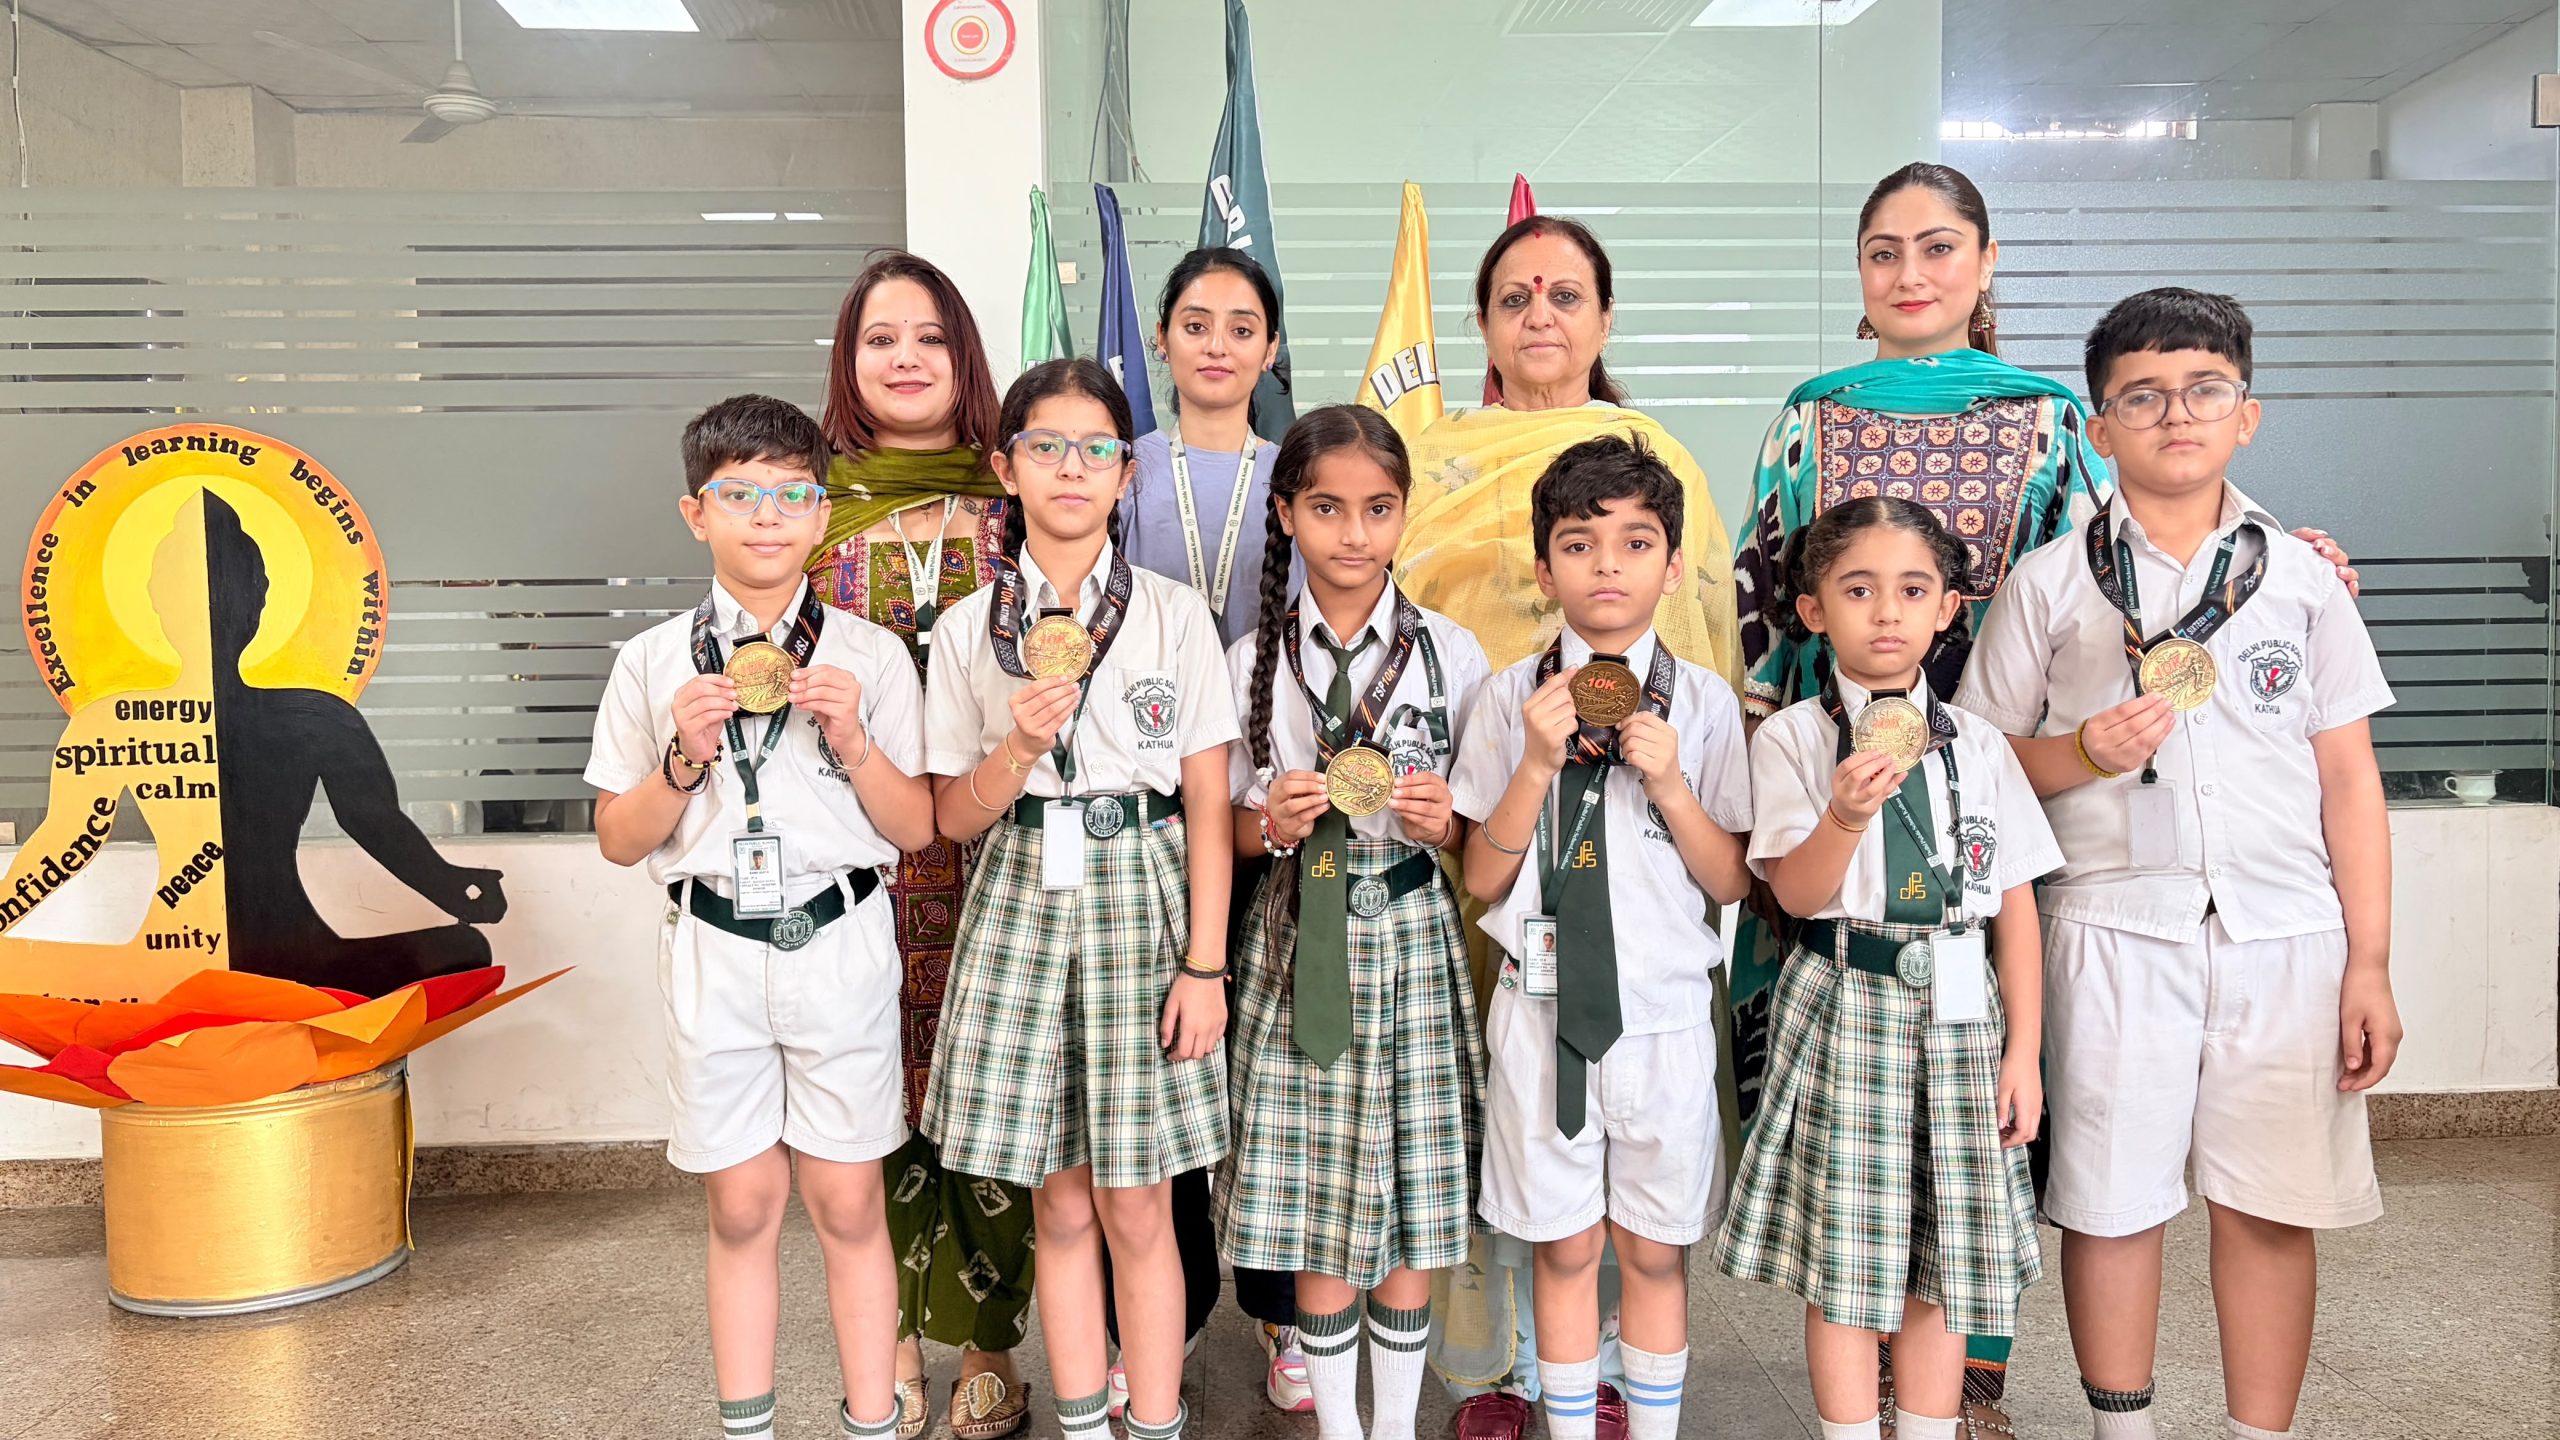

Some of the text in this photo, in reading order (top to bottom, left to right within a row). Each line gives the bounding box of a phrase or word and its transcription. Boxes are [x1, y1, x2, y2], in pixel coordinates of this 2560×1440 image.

[1369, 341, 1439, 410] DEL
[26, 532, 76, 696] Excellence
[62, 478, 97, 508] in
[121, 432, 261, 466] learning
[290, 459, 363, 545] begins
[2186, 614, 2208, 635] SIXTEEN
[2238, 643, 2261, 662] DELHI
[2261, 640, 2291, 650] PUBLIC
[1429, 667, 1437, 683] Public
[1121, 684, 1138, 704] DELHI
[1135, 677, 1164, 689] PUBLIC
[1588, 678, 1617, 690] 10K
[115, 699, 212, 724] energy
[2254, 704, 2281, 714] KATHUA
[766, 735, 775, 748] Delhi
[1137, 740, 1174, 750] KATHUA
[1401, 739, 1427, 750] PUBLIC
[55, 734, 217, 775] spiritual
[818, 766, 851, 784] KATHUA
[135, 776, 218, 800] calm
[1582, 803, 1591, 817] Delhi
[1576, 817, 1586, 832] Public
[1959, 815, 1988, 825] PUBLIC
[1915, 830, 1926, 845] Public
[1923, 843, 1933, 857] Delhi
[156, 841, 224, 910] peace
[1964, 880, 1992, 895] KATHUA
[146, 925, 221, 955] unity
